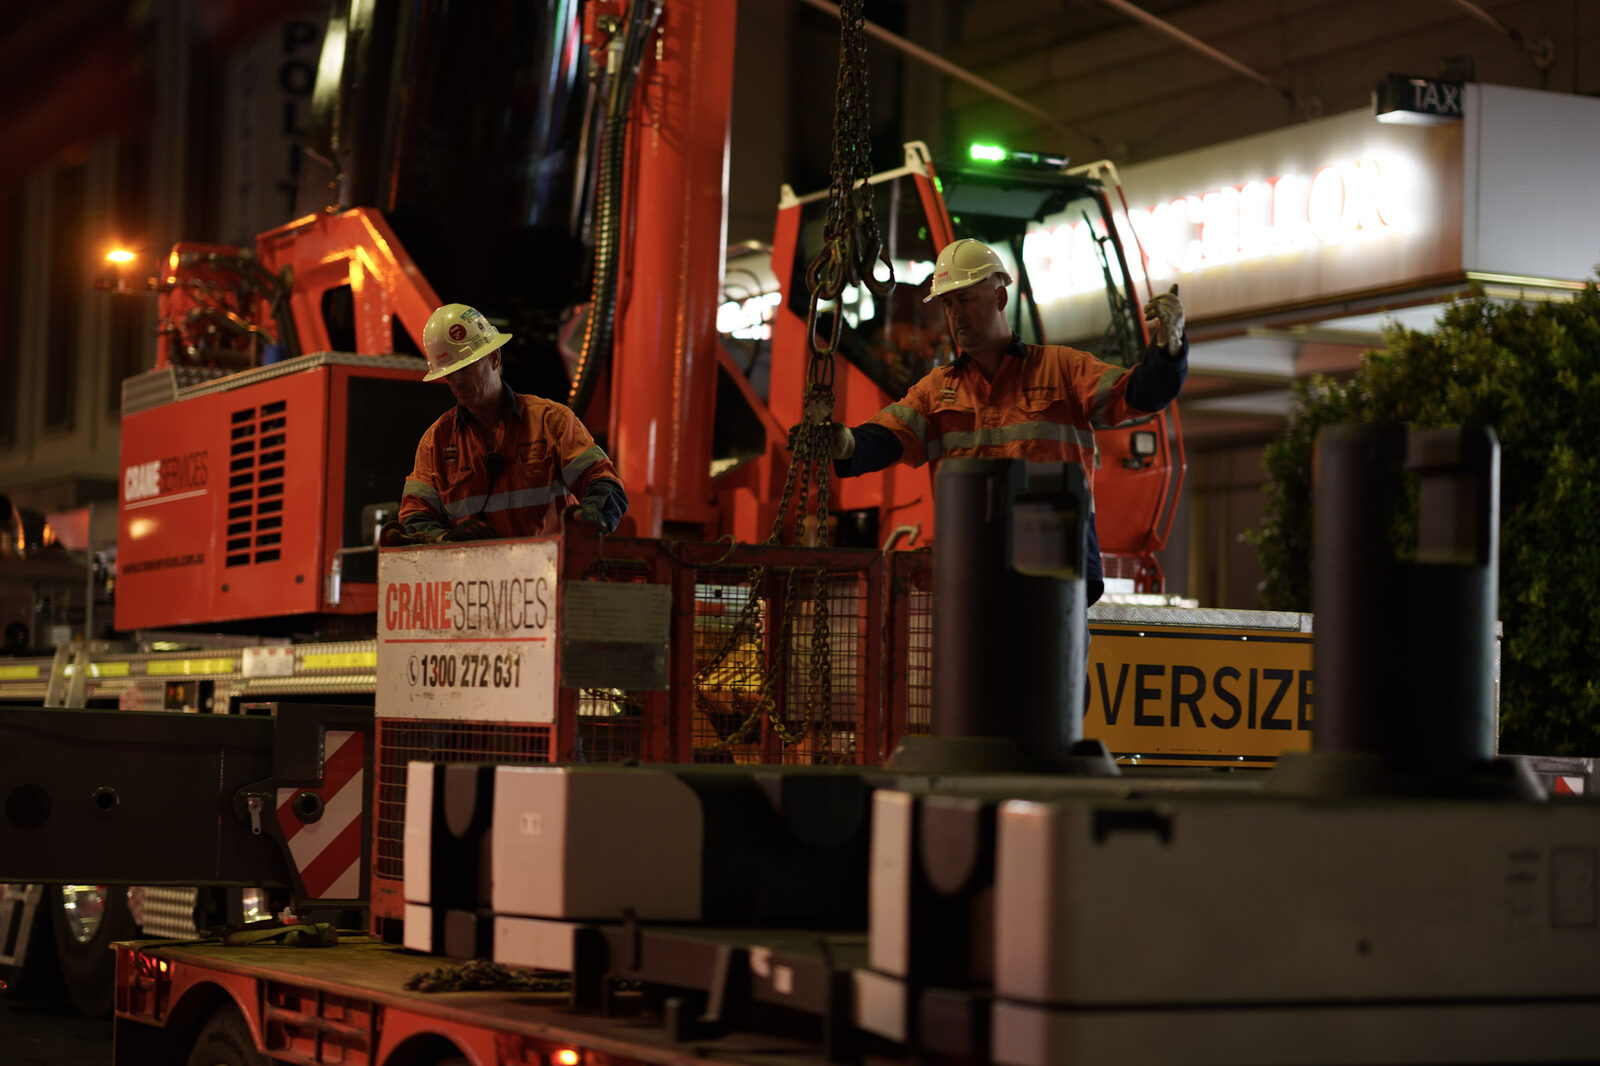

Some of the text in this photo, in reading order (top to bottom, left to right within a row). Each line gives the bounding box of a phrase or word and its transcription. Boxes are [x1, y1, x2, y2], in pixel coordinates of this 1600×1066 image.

[1410, 79, 1466, 114] TAX
[421, 654, 521, 688] 1300 272 631
[1083, 662, 1314, 731] VERSIZE
